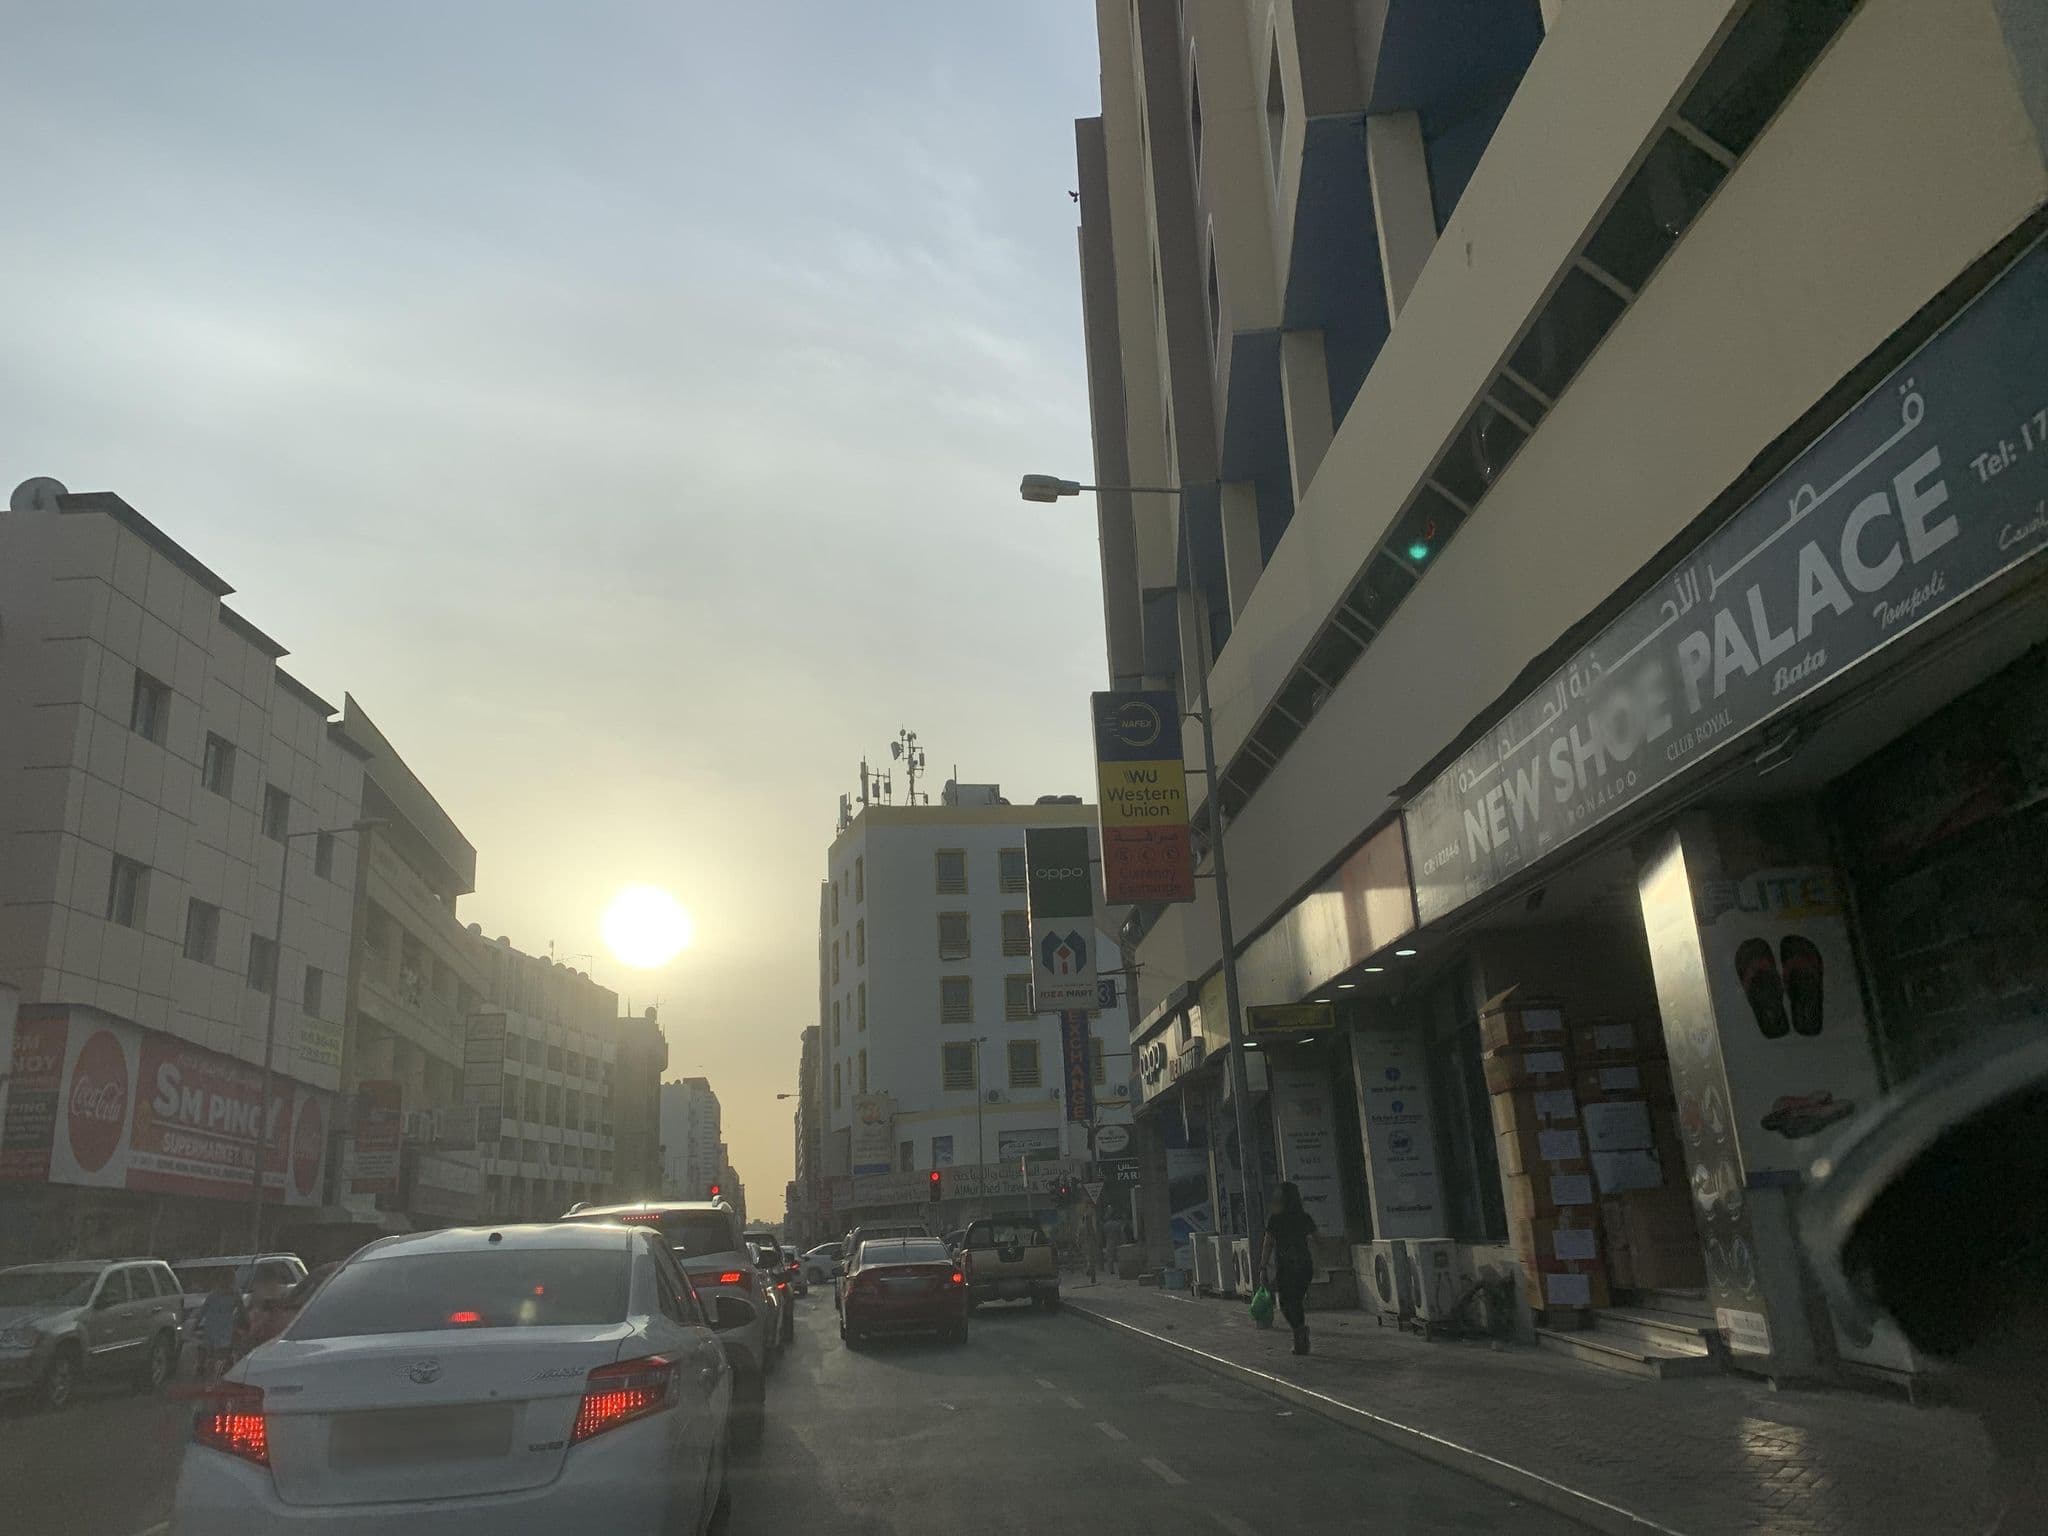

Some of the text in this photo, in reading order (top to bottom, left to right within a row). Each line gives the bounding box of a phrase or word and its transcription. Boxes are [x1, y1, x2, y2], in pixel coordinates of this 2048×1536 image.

[1969, 439, 2017, 483] Tel:
[1464, 445, 1959, 865] NEW SHOE PALACE
[1772, 648, 1828, 696] Bata
[1121, 718, 1152, 729] NAFEX
[1695, 709, 1733, 743] ROYAL
[1124, 768, 1158, 784] WU
[1107, 787, 1181, 802] Western
[1121, 803, 1170, 818] Union
[1035, 866, 1083, 882] oppo
[1066, 989, 1094, 1000] MART
[1068, 1009, 1086, 1120] EXCHANGE
[153, 1063, 204, 1125] SM
[1117, 1171, 1139, 1181] PAR
